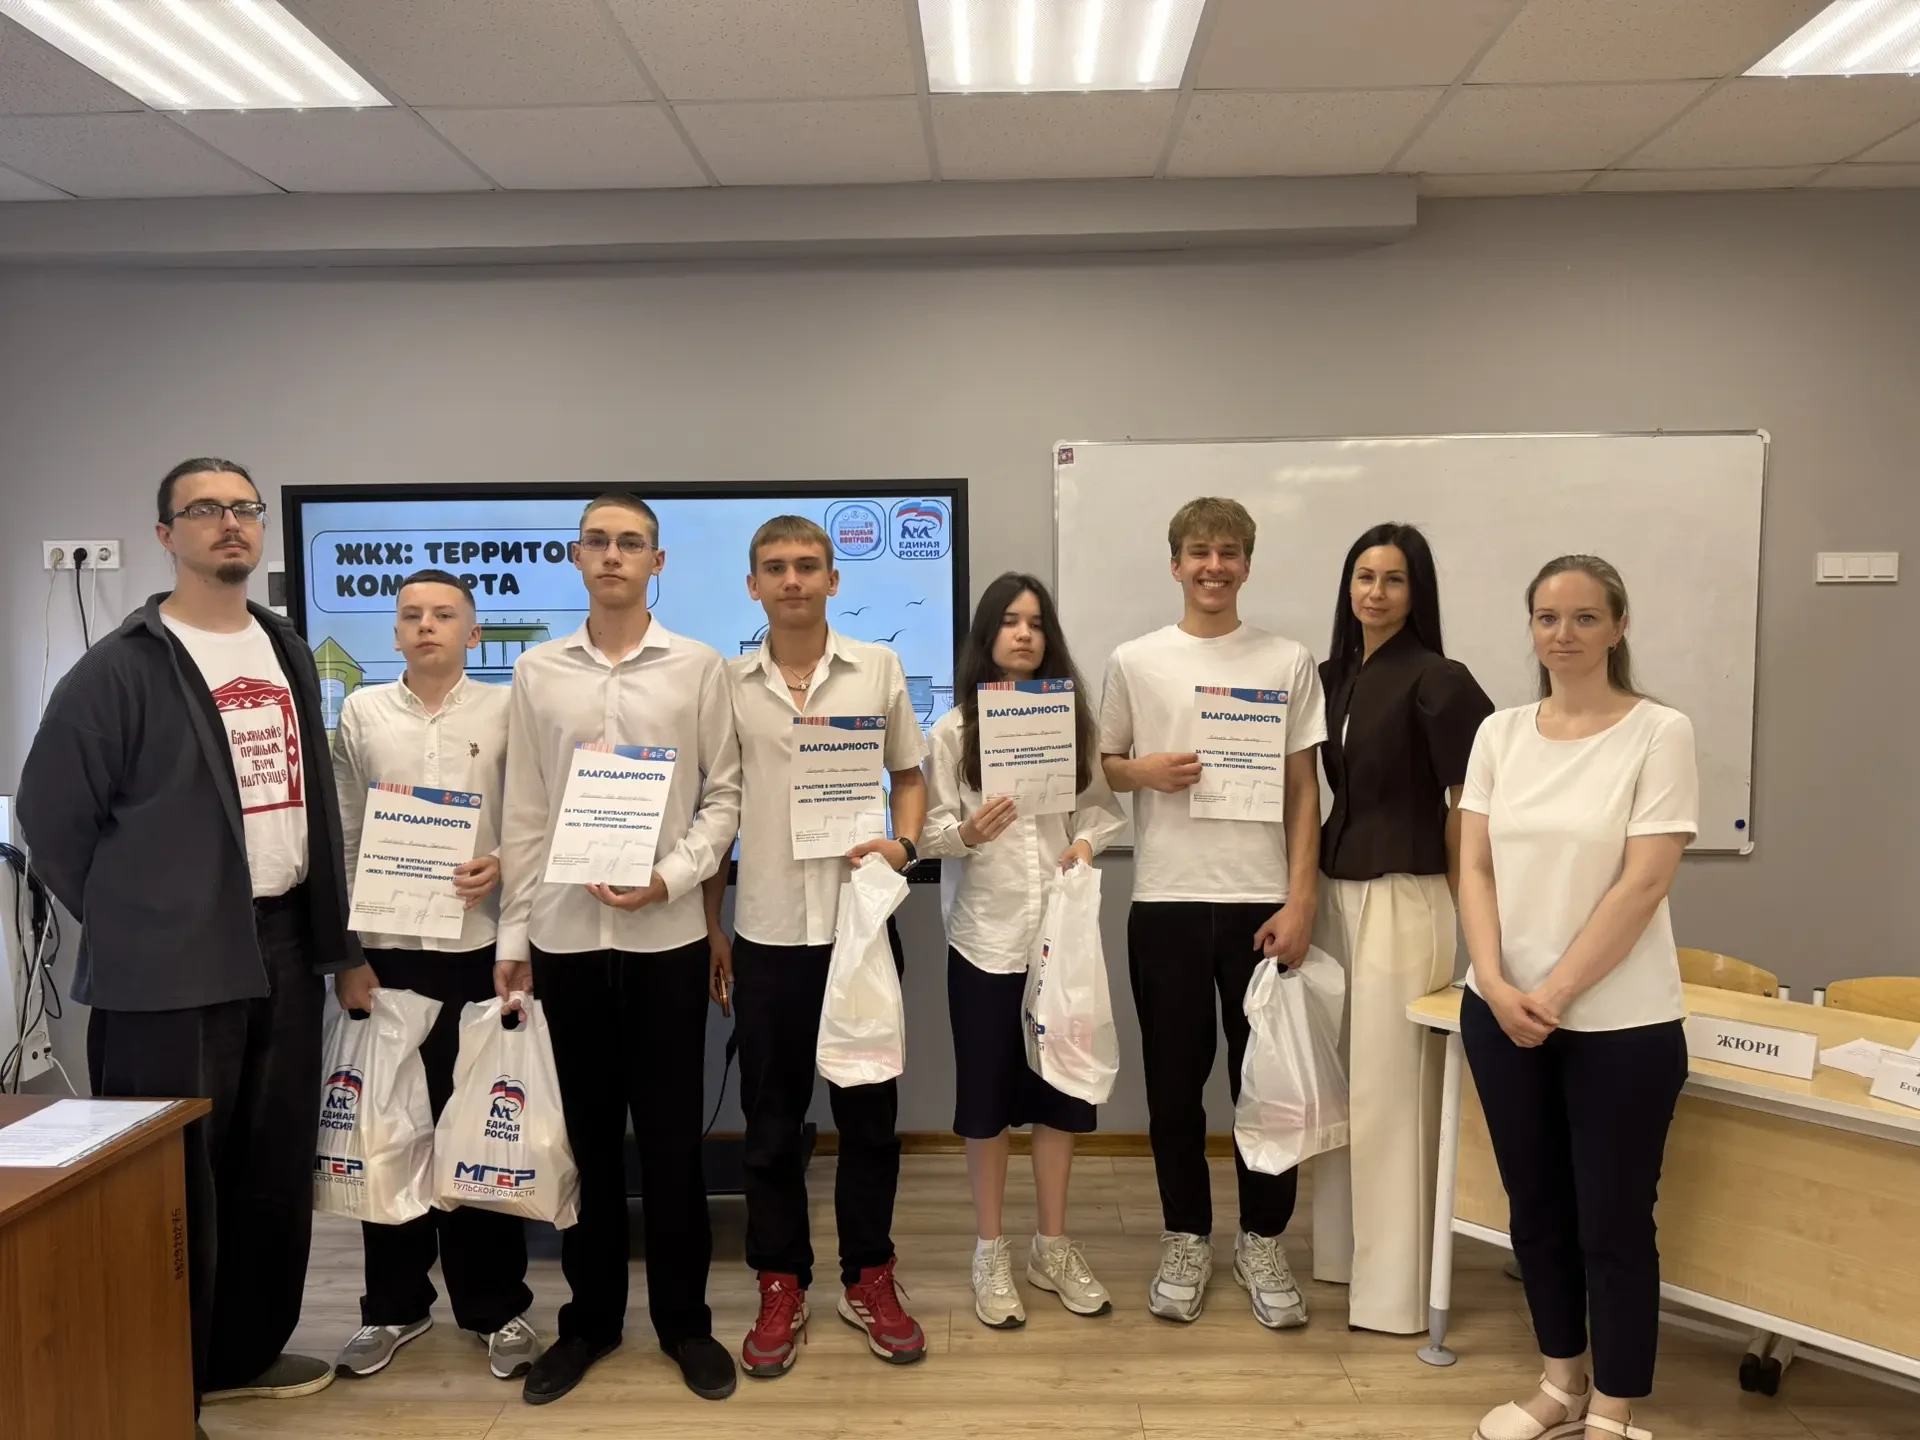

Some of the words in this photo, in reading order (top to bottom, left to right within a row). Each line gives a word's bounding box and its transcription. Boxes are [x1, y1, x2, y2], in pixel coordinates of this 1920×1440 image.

[334, 542, 413, 565] ЖКХ:
[424, 541, 575, 564] ТЕРРИТО
[335, 573, 520, 597] КОМРТА
[987, 705, 1070, 717] БЛАГОДАРНОСТЬ
[1201, 712, 1281, 723] БЛАГОДАРНОСТЬ
[800, 742, 879, 752] БЛАГОДАРНОСТЬ
[578, 769, 666, 781] БЛАГОДАРНОСТЬ
[374, 811, 472, 829] БЛАГОДАРНОСТЬ
[406, 858, 466, 867] ИНТЕЛЛЕКТУАЛЬНО
[385, 870, 422, 878] ТЕРРИТОРИЯ
[1716, 1034, 1780, 1057] ЖЮРИ
[455, 1162, 536, 1187] МГЕР
[453, 1182, 495, 1195] ТУЛЬСКОЙ
[497, 1189, 535, 1198] ОБЛАСТИ
